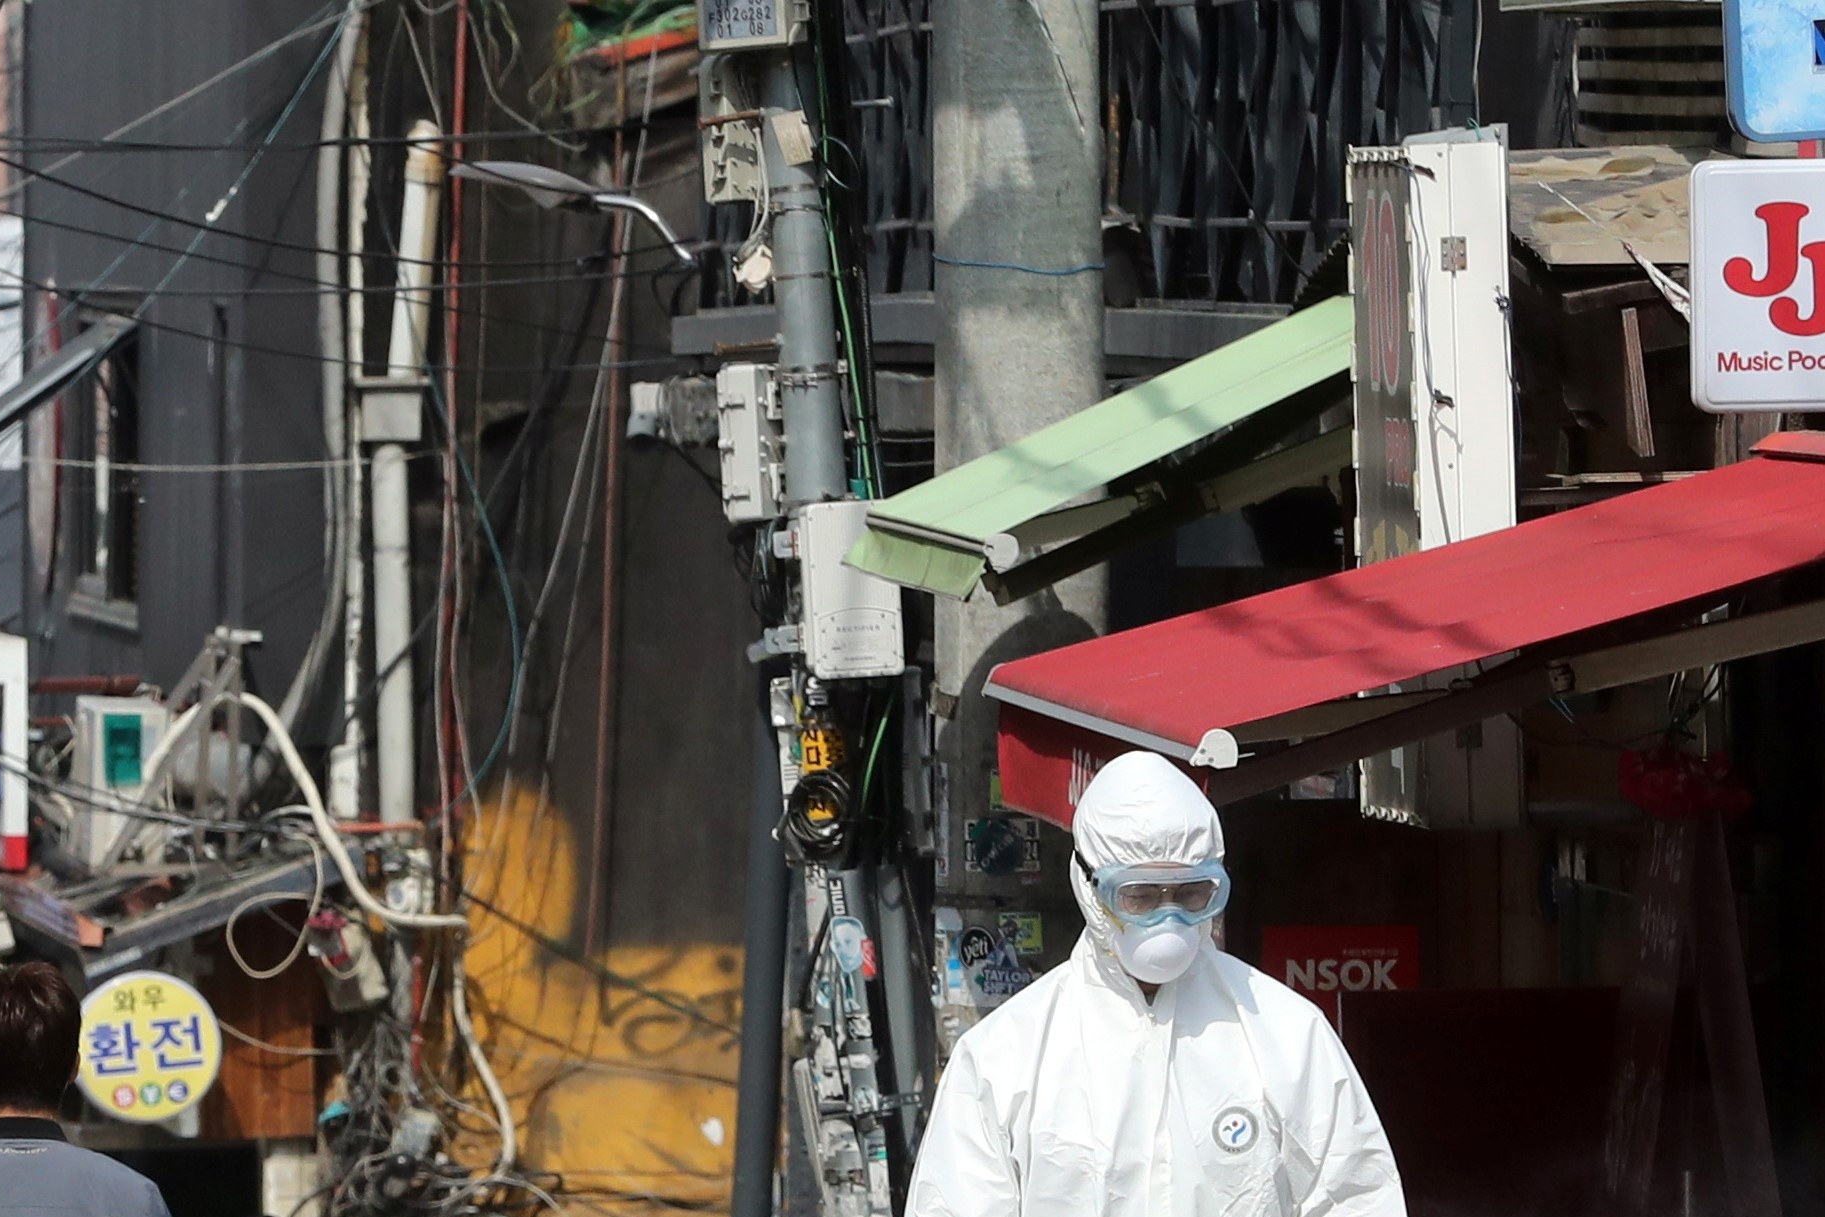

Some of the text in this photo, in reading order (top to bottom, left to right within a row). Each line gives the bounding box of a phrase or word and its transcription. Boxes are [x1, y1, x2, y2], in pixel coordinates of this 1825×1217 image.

[1717, 351, 1784, 372] Music
[1286, 958, 1399, 991] NSOK
[113, 984, 168, 1014] 와우
[88, 1015, 204, 1076] 환전
